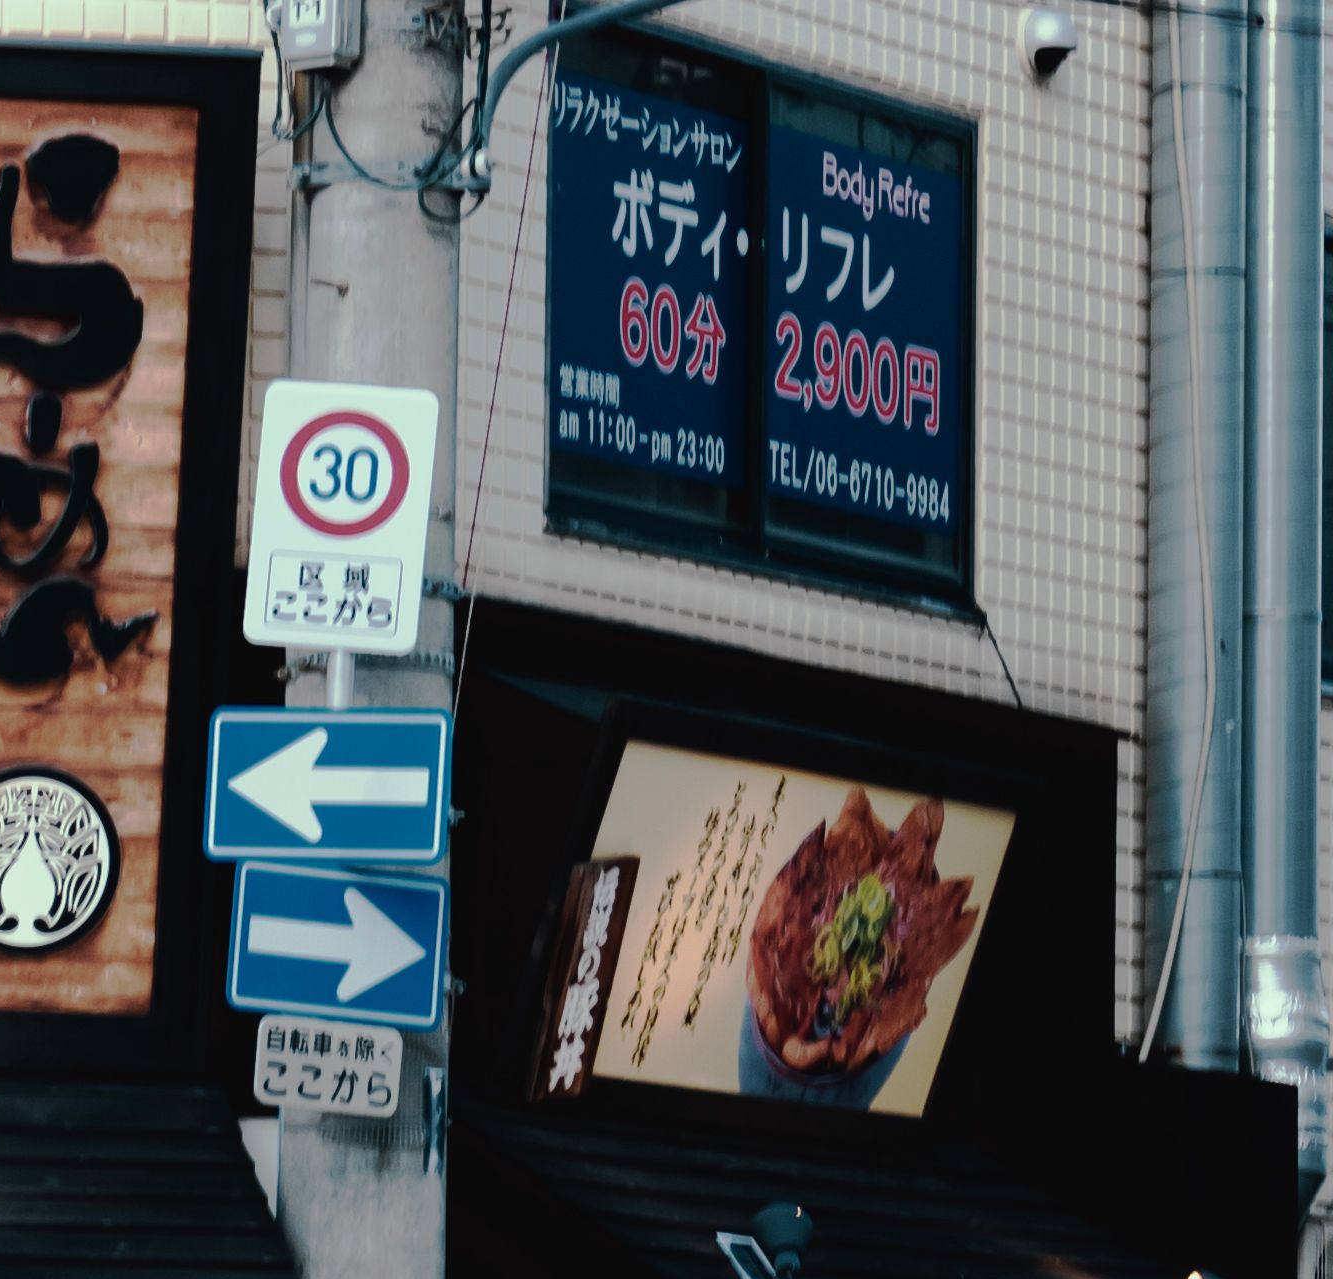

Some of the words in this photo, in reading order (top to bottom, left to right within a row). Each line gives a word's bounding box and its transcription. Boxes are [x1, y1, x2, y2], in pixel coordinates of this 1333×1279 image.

[554, 80, 743, 175] リラクゼーションサロン
[822, 151, 875, 221] Body
[878, 168, 931, 225] Refre
[782, 205, 895, 312] リフレ
[559, 362, 620, 410] 営業時間
[619, 275, 727, 385] 60分
[773, 310, 941, 437] 2,900円
[309, 442, 380, 504] 30
[559, 408, 580, 441] am
[677, 427, 725, 475] 23:00
[768, 438, 950, 524] TEL/06-6710-9984
[272, 591, 393, 629] ここから
[266, 1025, 394, 1065] 自転車を除く
[263, 1067, 393, 1107] ここから
